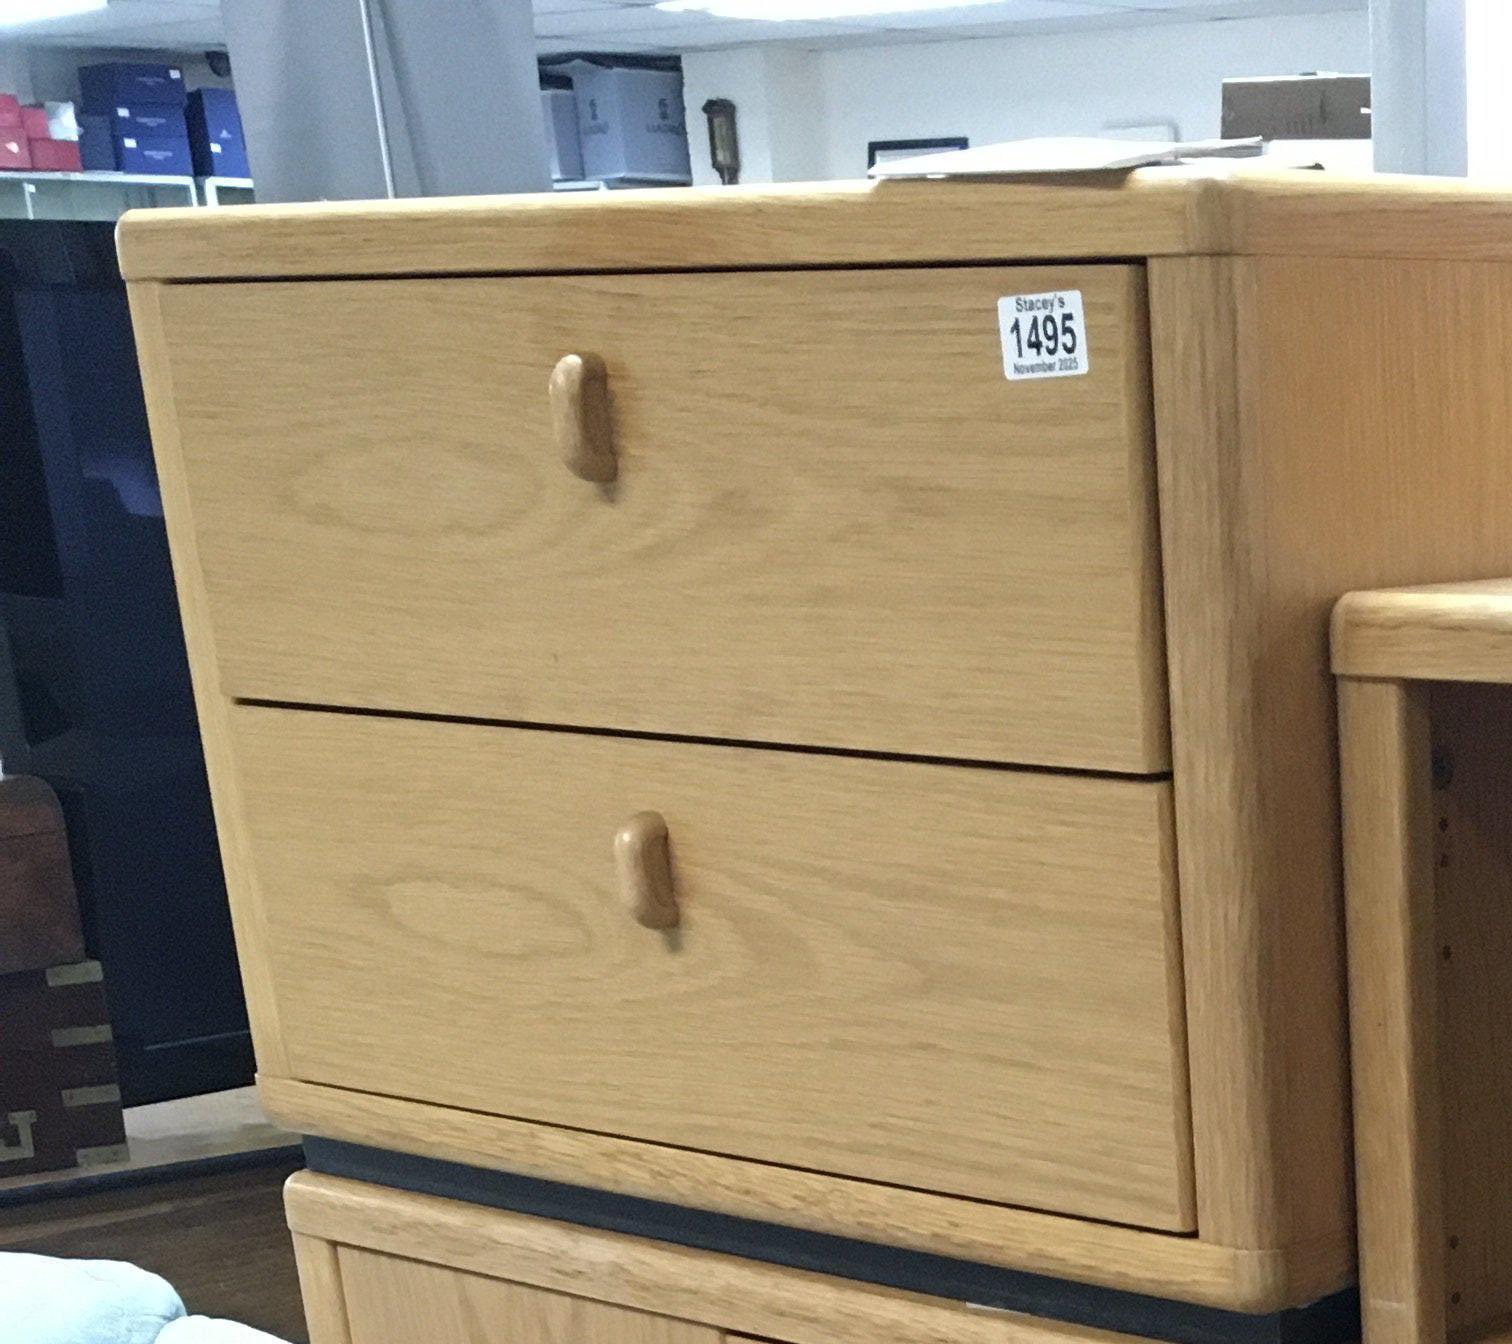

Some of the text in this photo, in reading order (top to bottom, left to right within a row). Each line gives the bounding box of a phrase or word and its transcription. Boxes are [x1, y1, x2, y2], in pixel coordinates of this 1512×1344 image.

[1015, 294, 1066, 313] Stacey's
[1010, 312, 1077, 358] 1495
[1013, 359, 1056, 375] November
